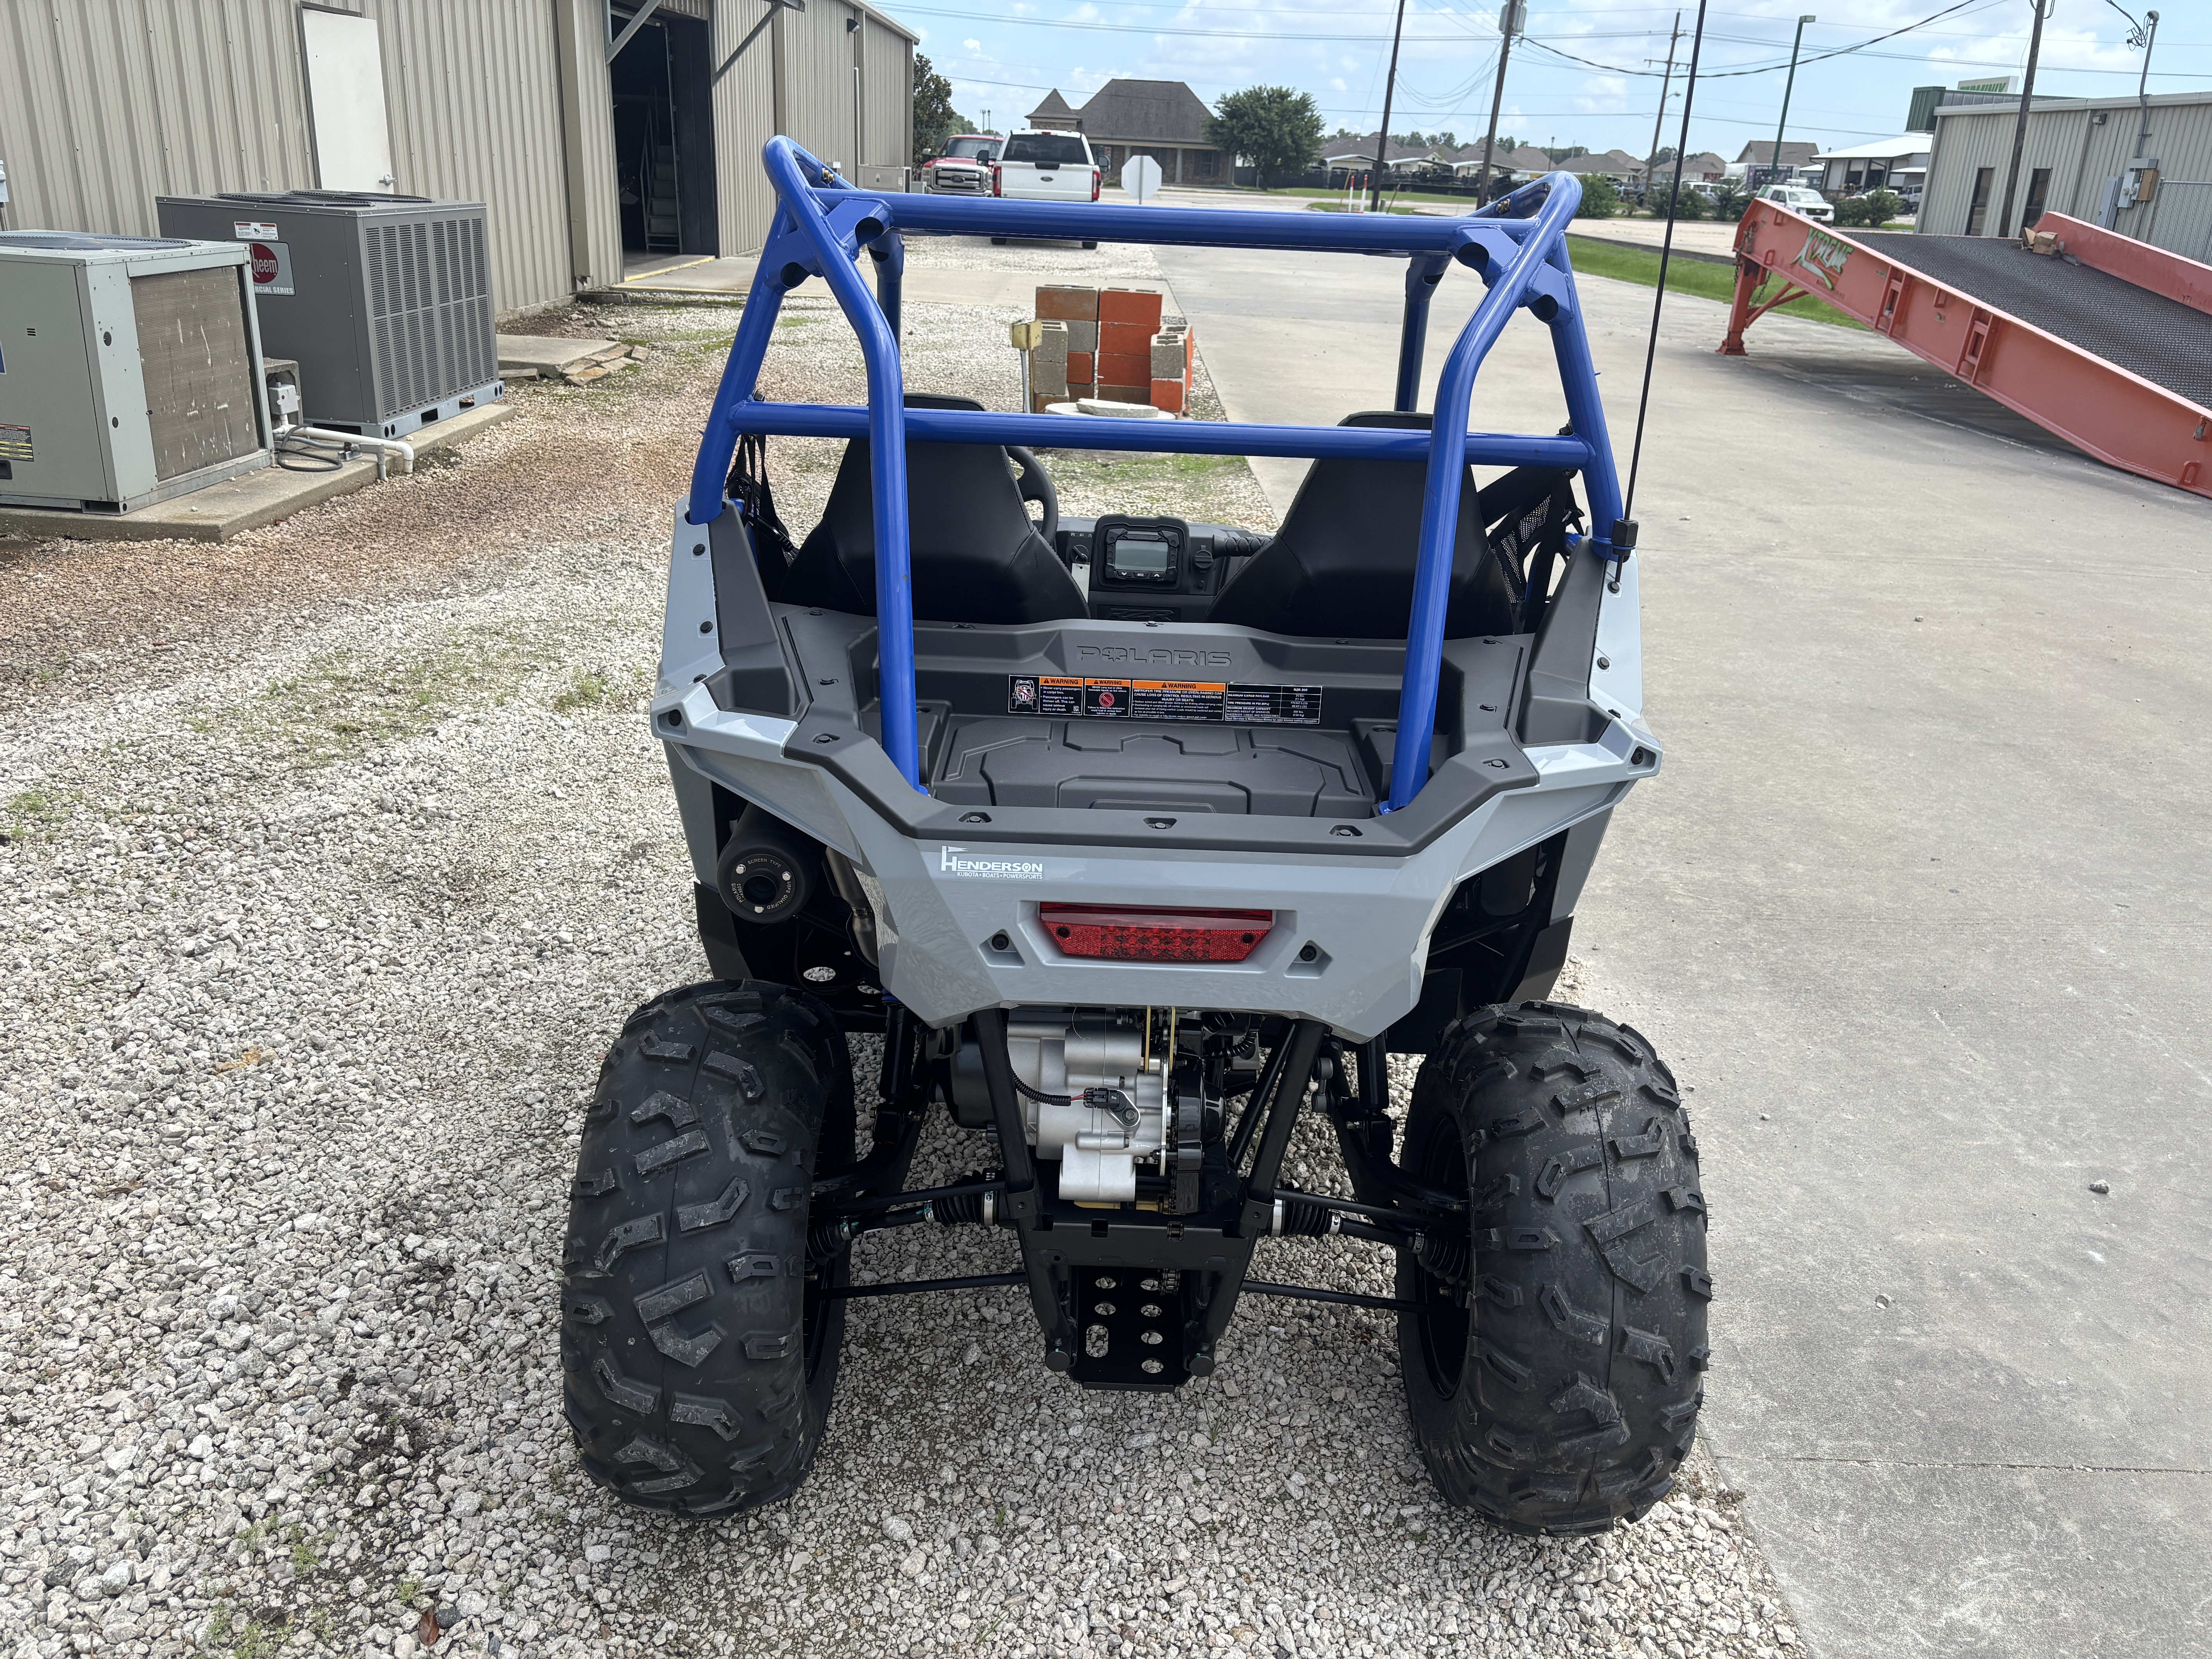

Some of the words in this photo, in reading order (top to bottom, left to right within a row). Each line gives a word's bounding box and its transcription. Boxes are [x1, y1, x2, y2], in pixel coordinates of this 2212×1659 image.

[251, 244, 277, 278] heem
[1108, 608, 1174, 622] RZR
[1076, 646, 1232, 666] POLARIS
[770, 860, 781, 868] TYPE
[941, 845, 1043, 872] HENDERSON
[731, 883, 744, 903] POLARIS
[767, 895, 788, 909] QUALIFIED
